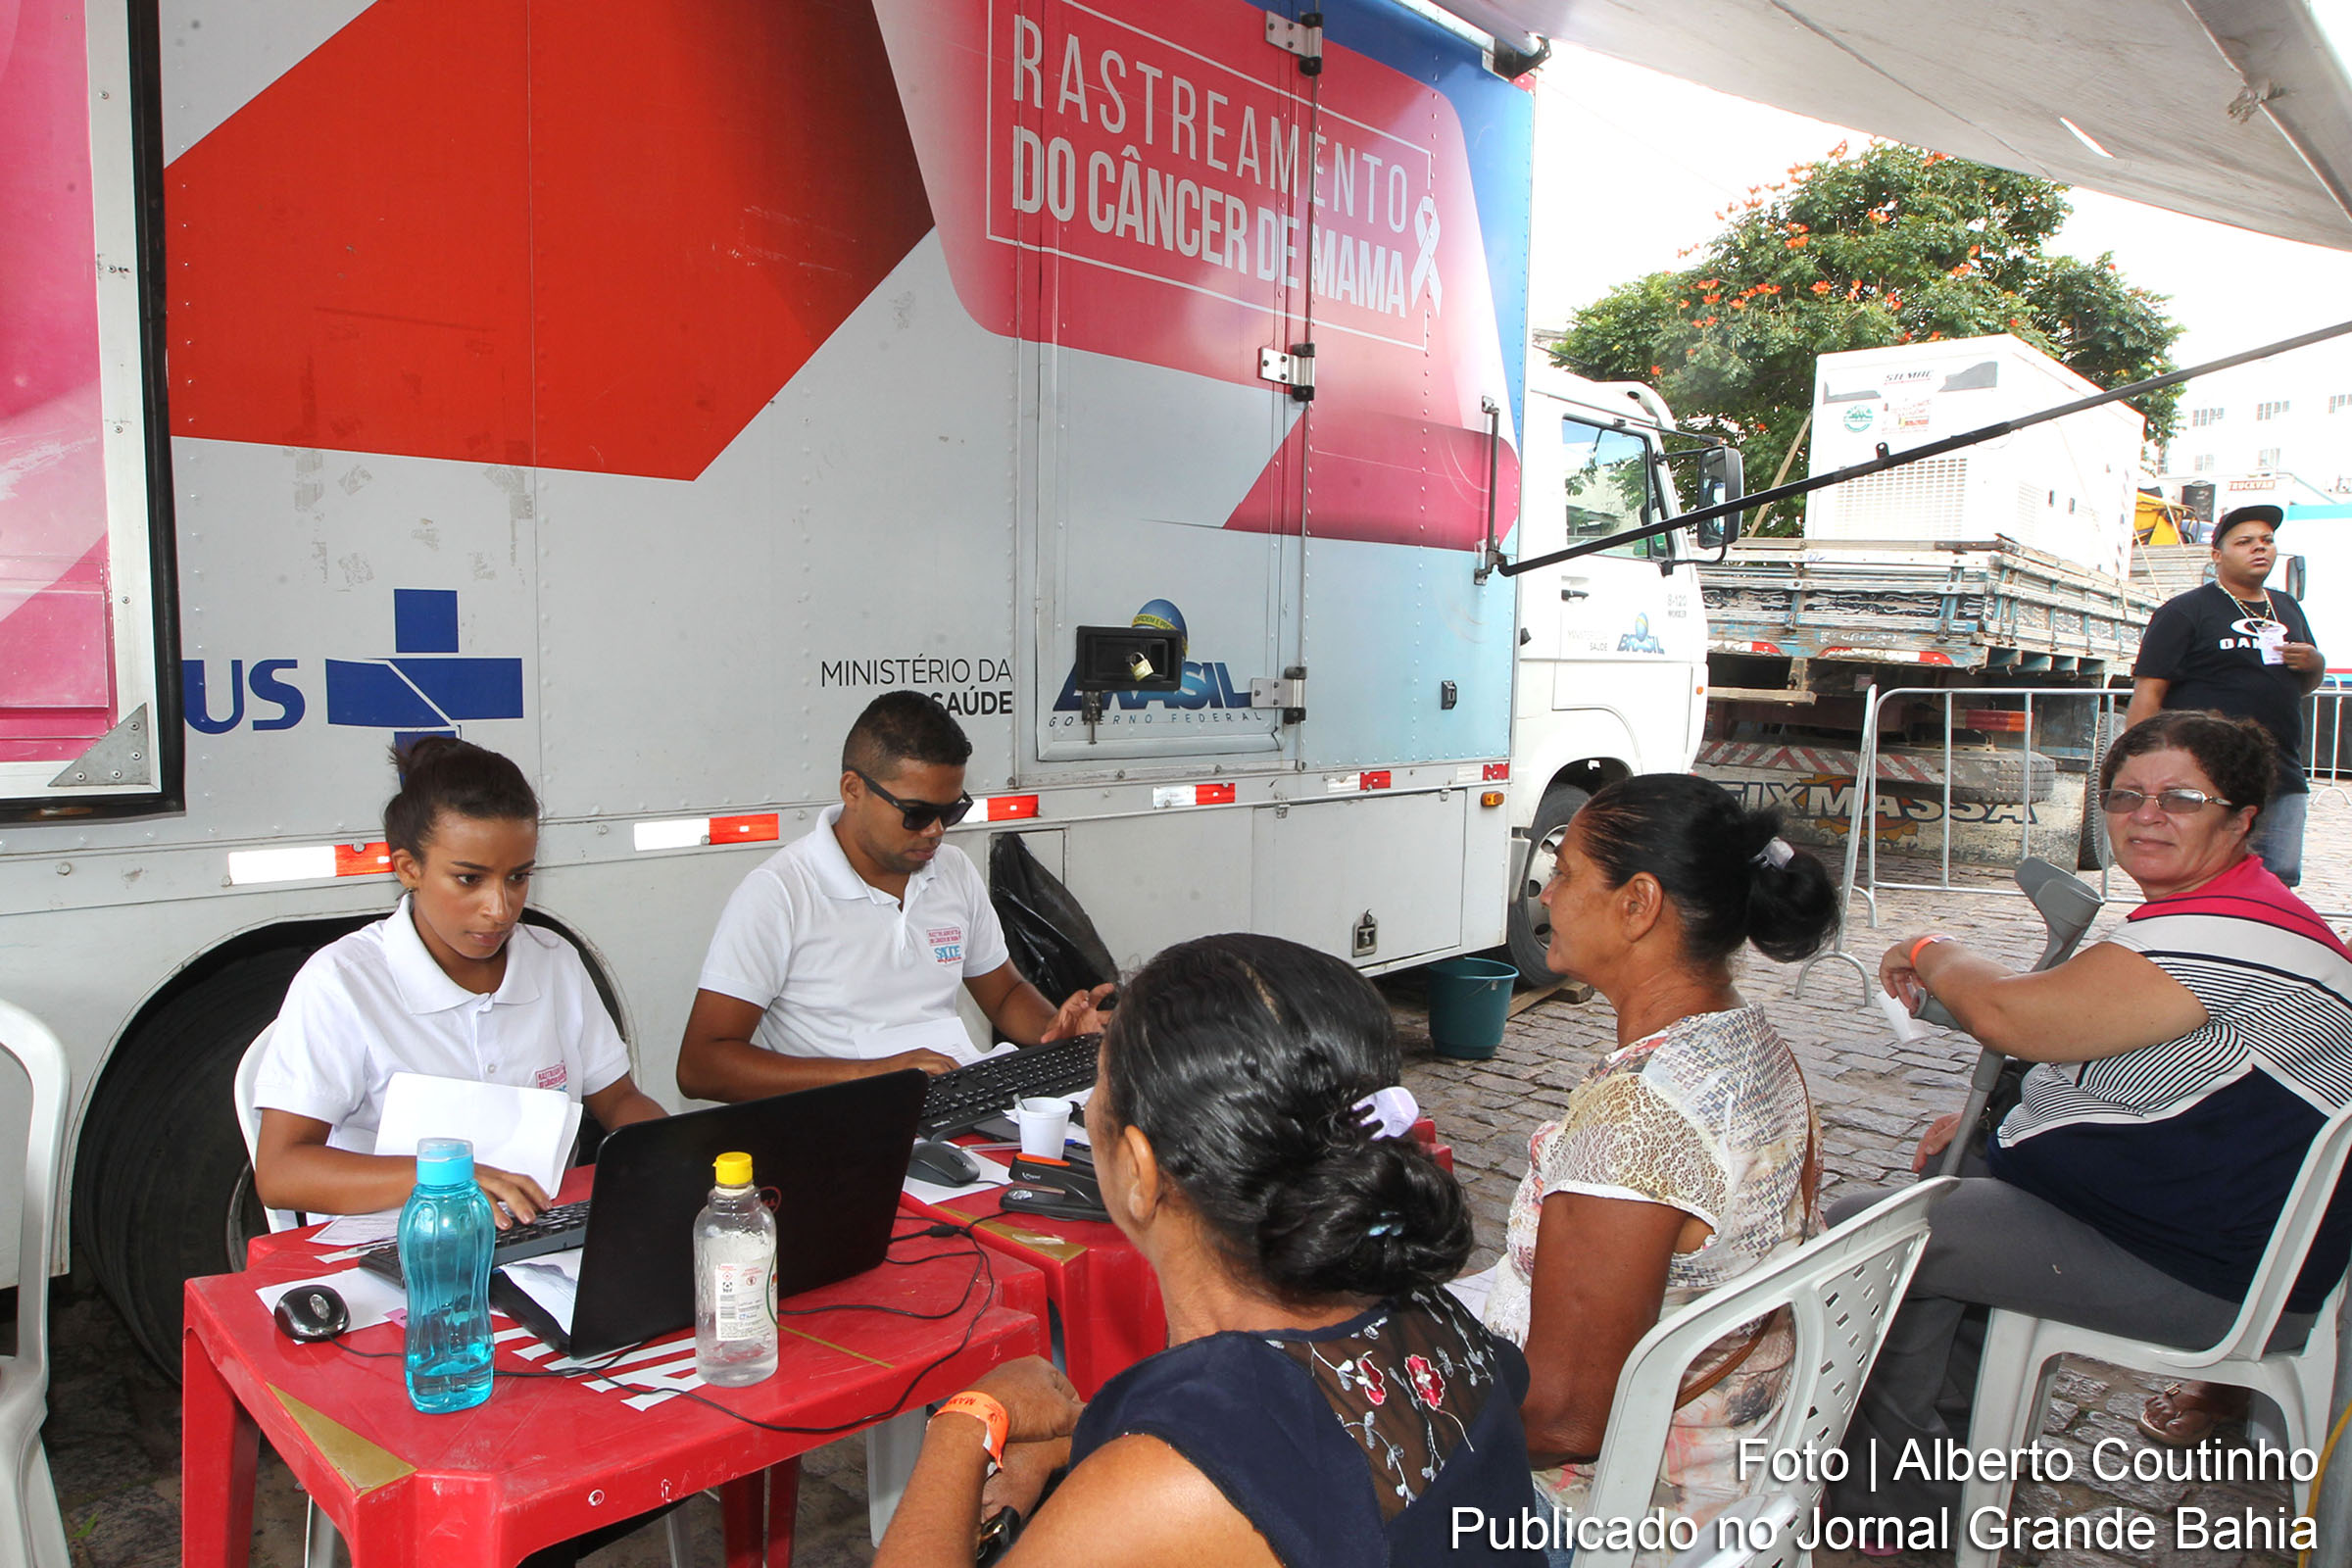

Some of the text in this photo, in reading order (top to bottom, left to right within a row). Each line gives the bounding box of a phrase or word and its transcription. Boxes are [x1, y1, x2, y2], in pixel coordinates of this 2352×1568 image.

[1012, 14, 1407, 233] RASTREAMENTO
[1012, 126, 1406, 318] DO CÂNCER DE MAMA
[182, 658, 307, 735] US
[821, 653, 1013, 688] MINISTÉRIO DA
[931, 684, 1013, 716] SAÚDE
[1049, 711, 1262, 728] GOERNO FEDERAL
